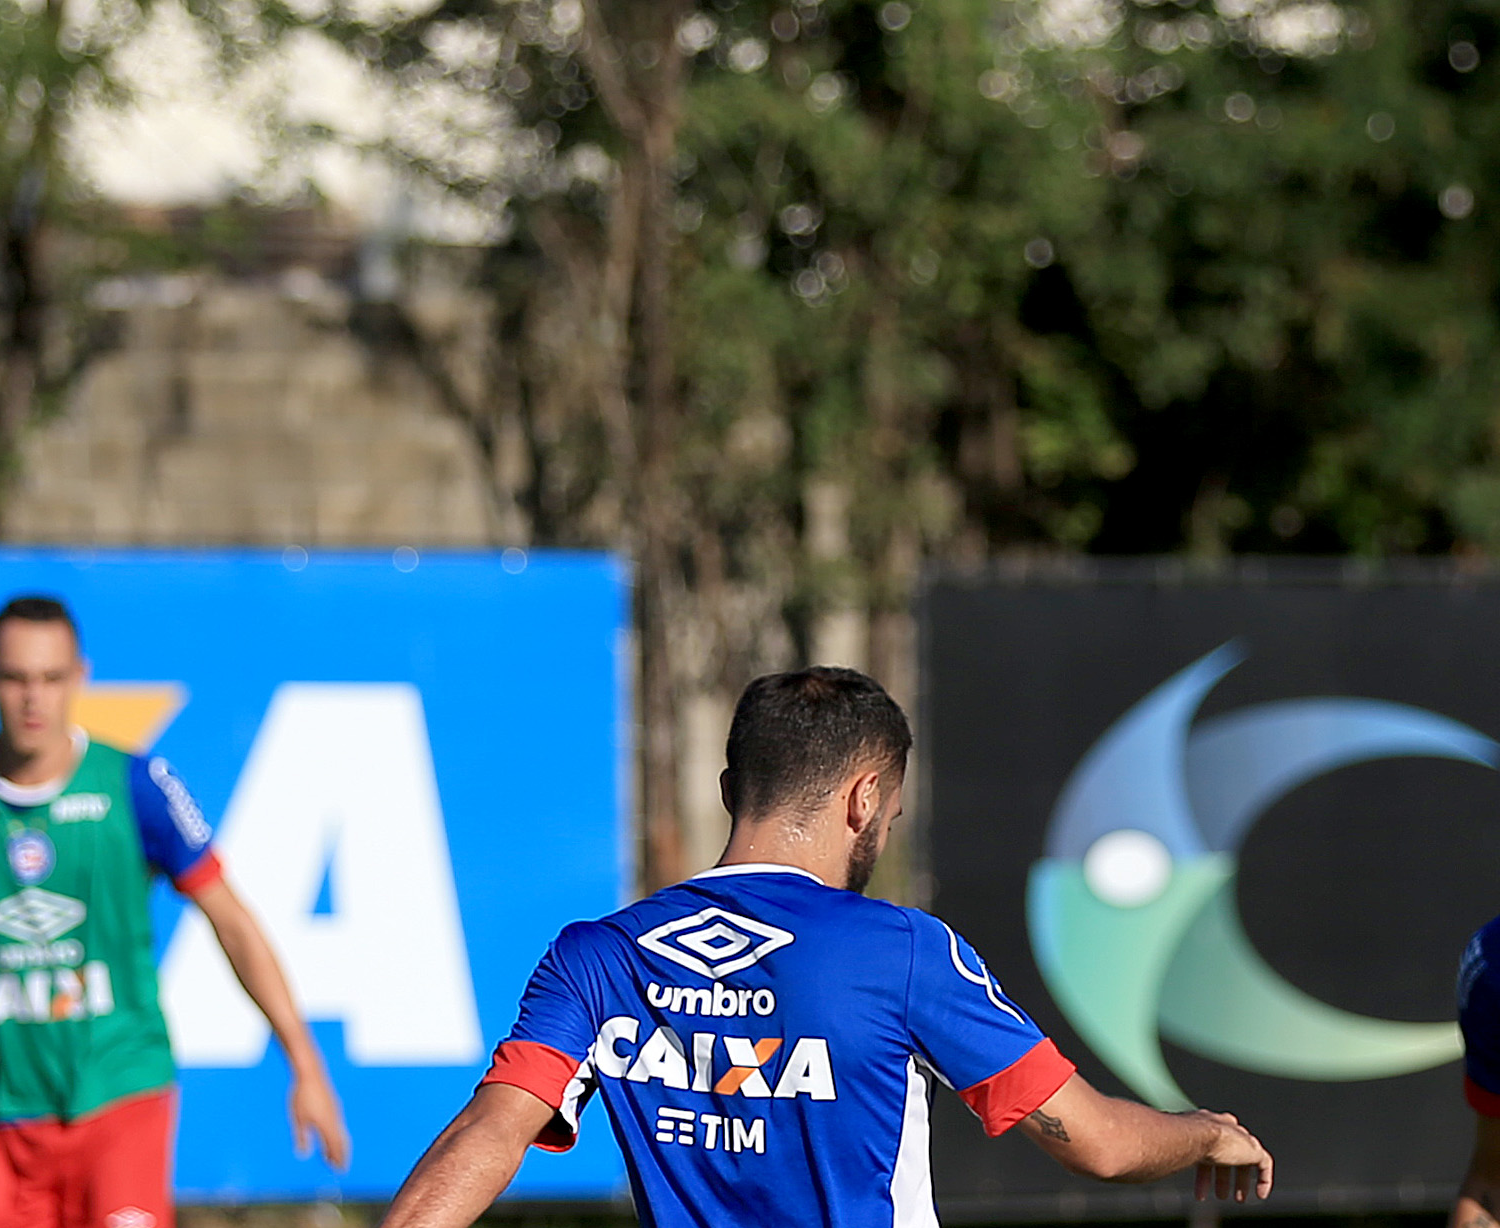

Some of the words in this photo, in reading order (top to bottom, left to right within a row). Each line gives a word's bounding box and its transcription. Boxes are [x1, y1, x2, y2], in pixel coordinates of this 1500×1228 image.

[647, 981, 776, 1017] umbro
[595, 1016, 837, 1100] CAIXA
[700, 1113, 766, 1155] TIM
